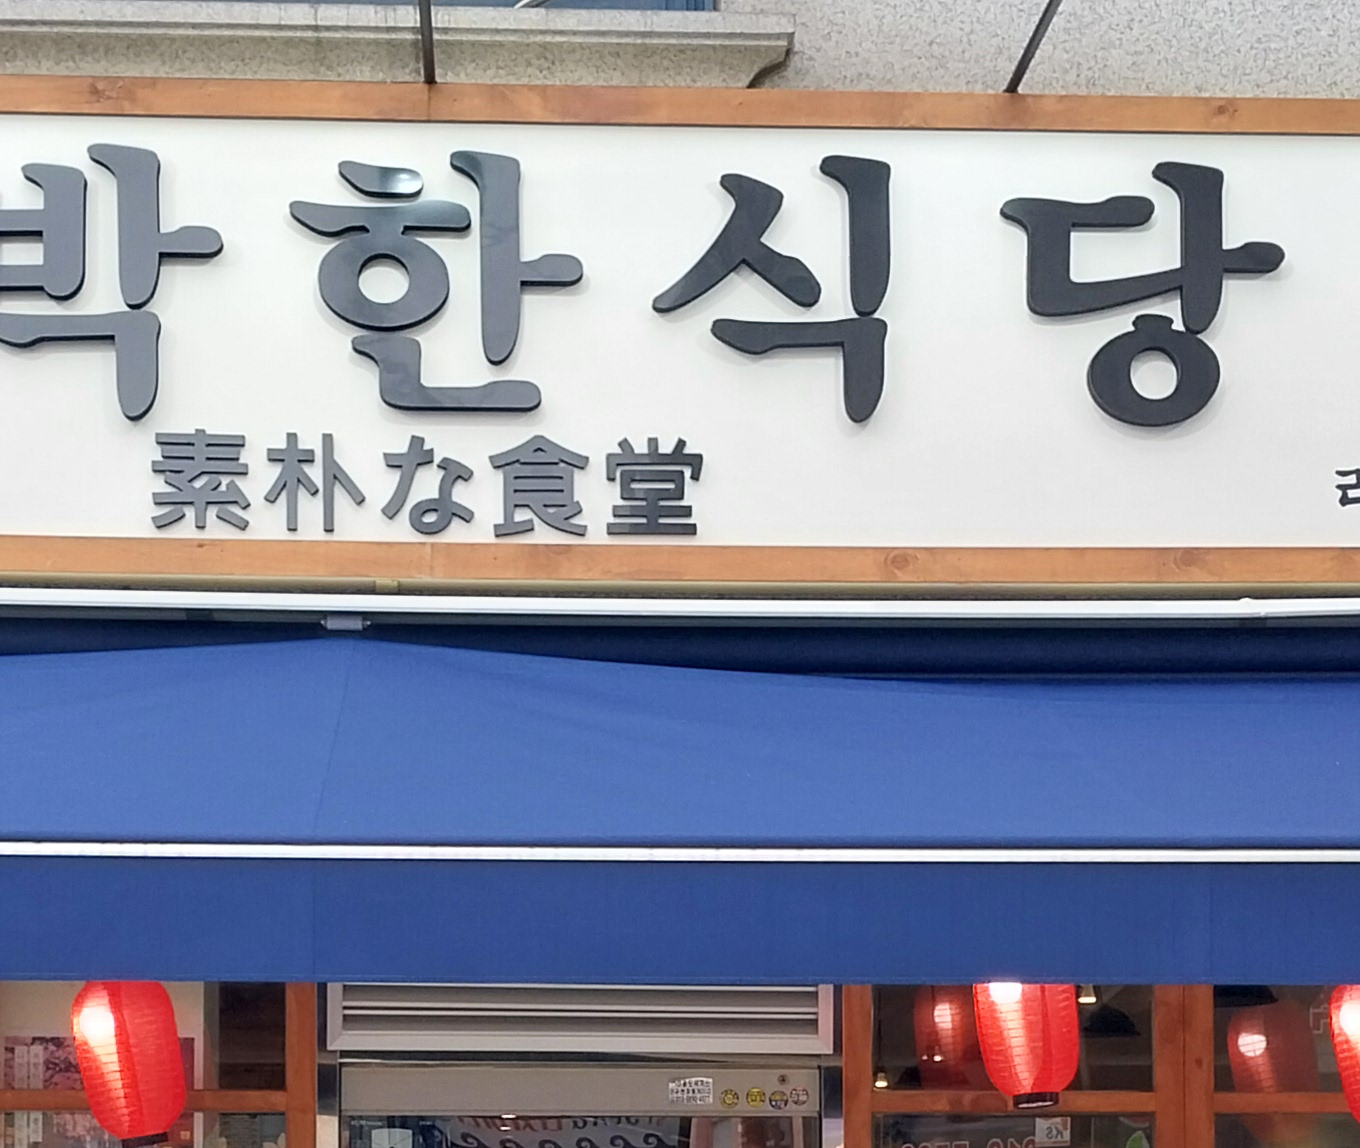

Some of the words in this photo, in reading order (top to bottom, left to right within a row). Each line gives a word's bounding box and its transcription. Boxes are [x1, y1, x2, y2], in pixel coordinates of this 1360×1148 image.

[150, 428, 703, 540] 素朴な食堂
